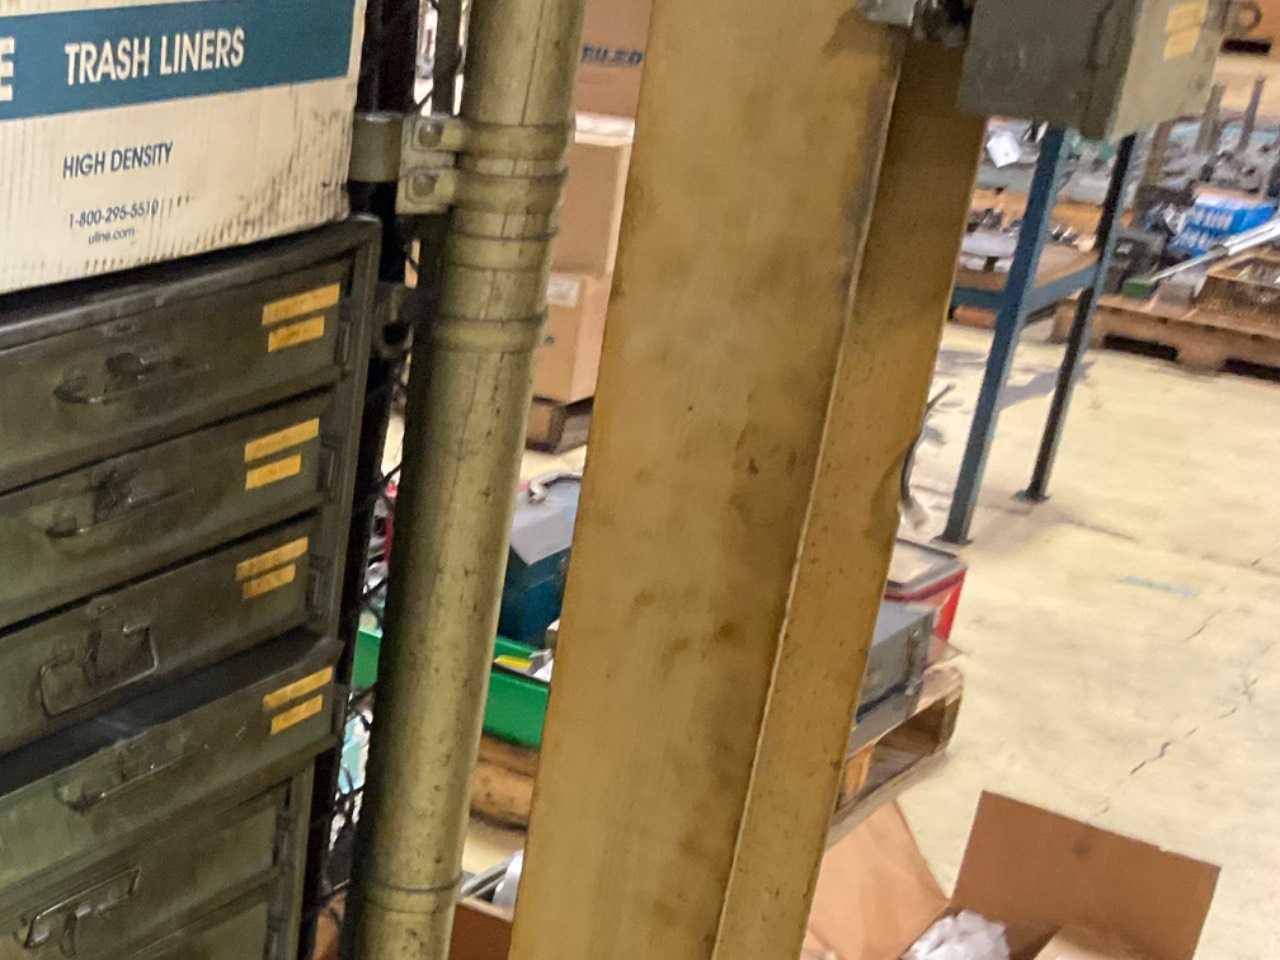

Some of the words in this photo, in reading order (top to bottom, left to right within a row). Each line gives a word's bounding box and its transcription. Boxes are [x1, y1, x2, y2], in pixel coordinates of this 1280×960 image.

[65, 40, 150, 86] TRASH
[159, 28, 245, 76] LINERS
[63, 151, 105, 179] HIGH
[110, 141, 173, 172] DENSITY
[69, 198, 159, 229] 1-800-295-5510
